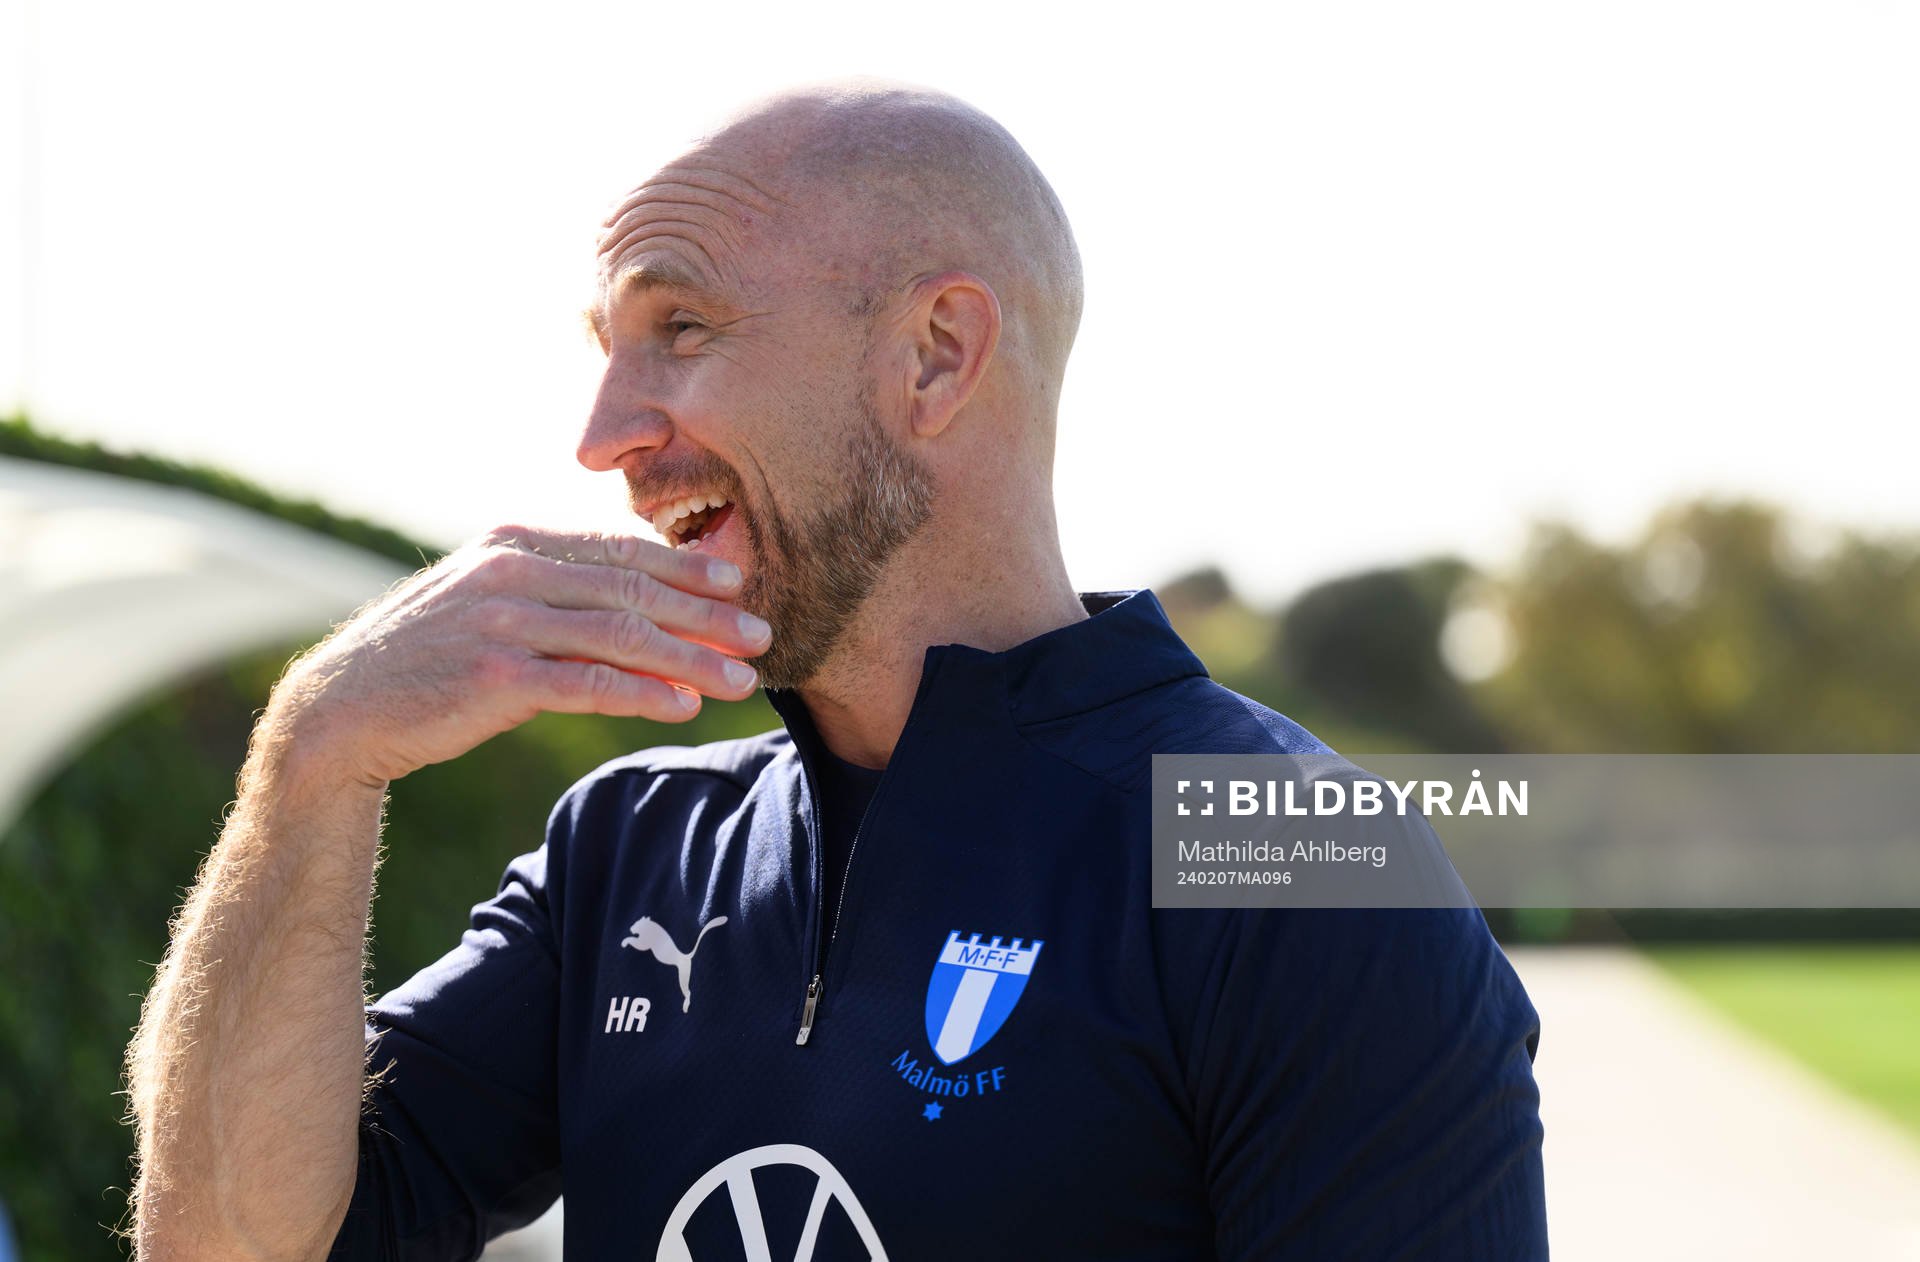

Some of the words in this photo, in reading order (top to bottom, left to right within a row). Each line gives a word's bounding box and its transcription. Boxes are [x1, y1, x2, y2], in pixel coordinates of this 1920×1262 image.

[605, 997, 651, 1033] HR
[891, 1050, 970, 1097] Malmö
[976, 1066, 1006, 1095] FF
